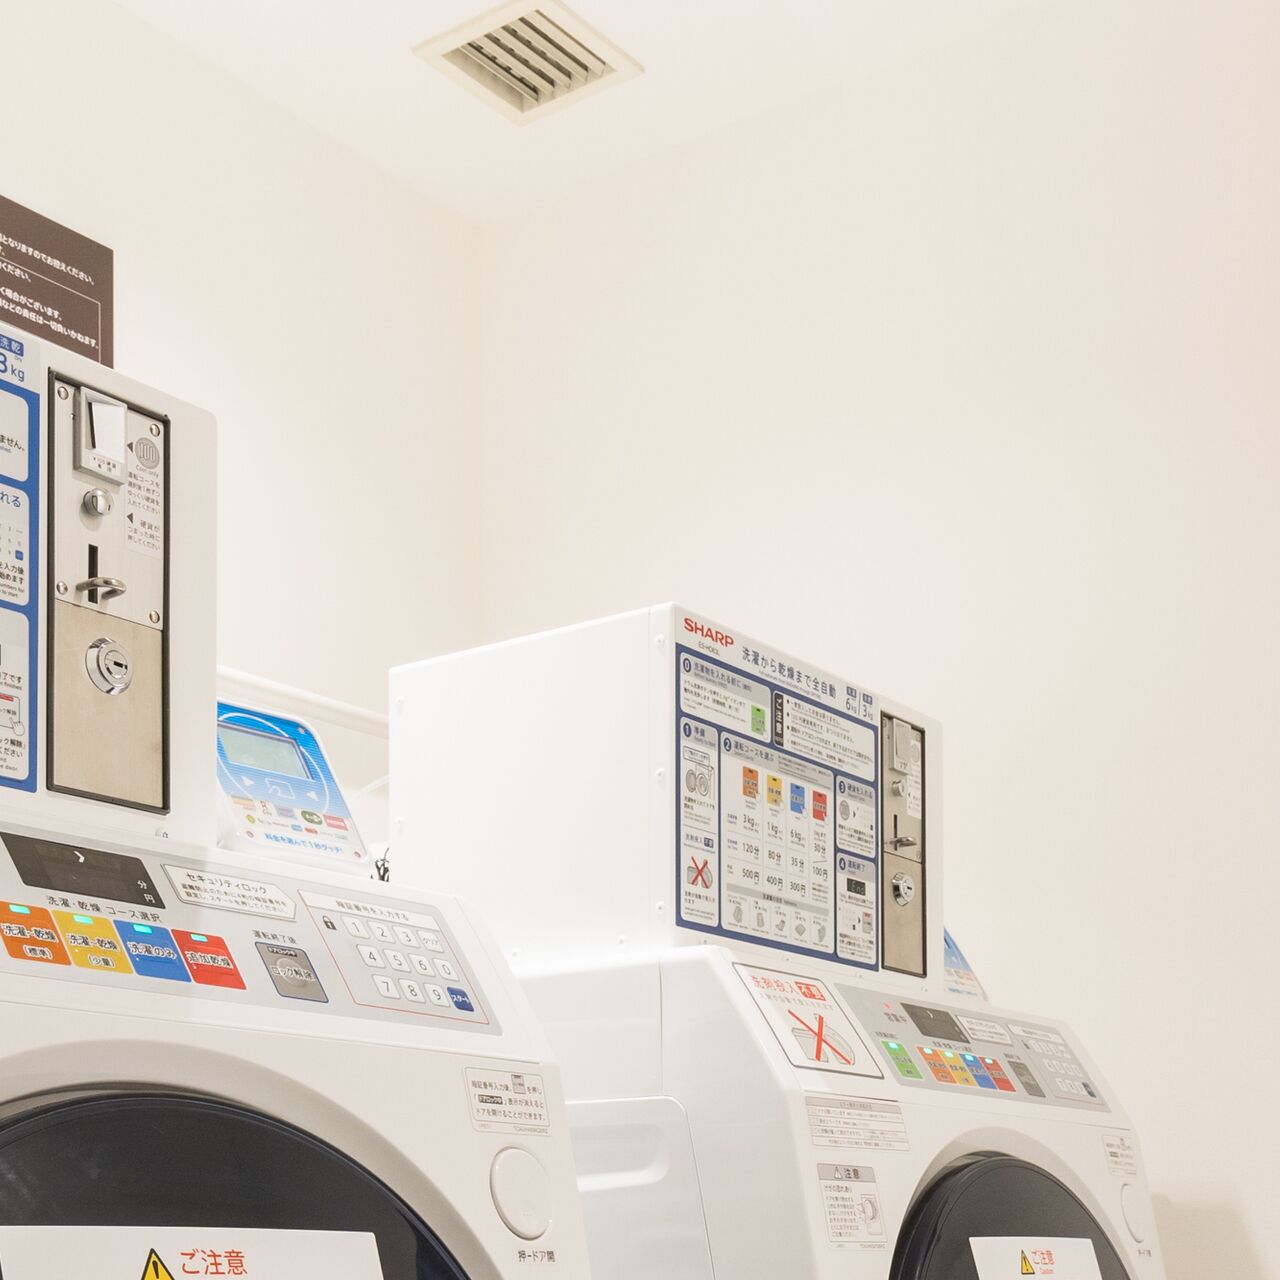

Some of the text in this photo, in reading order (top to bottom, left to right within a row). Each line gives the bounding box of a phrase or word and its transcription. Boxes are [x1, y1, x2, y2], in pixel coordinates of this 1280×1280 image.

[684, 617, 734, 648] SHARP
[742, 646, 836, 699] 洗濯から乾燥まで全自動
[187, 872, 267, 894] セキュリティロック
[129, 942, 176, 959] 洗濯のみ
[185, 950, 230, 967] 追加乾燥
[179, 1248, 247, 1277] ご注意
[1032, 1250, 1055, 1265] ご注意
